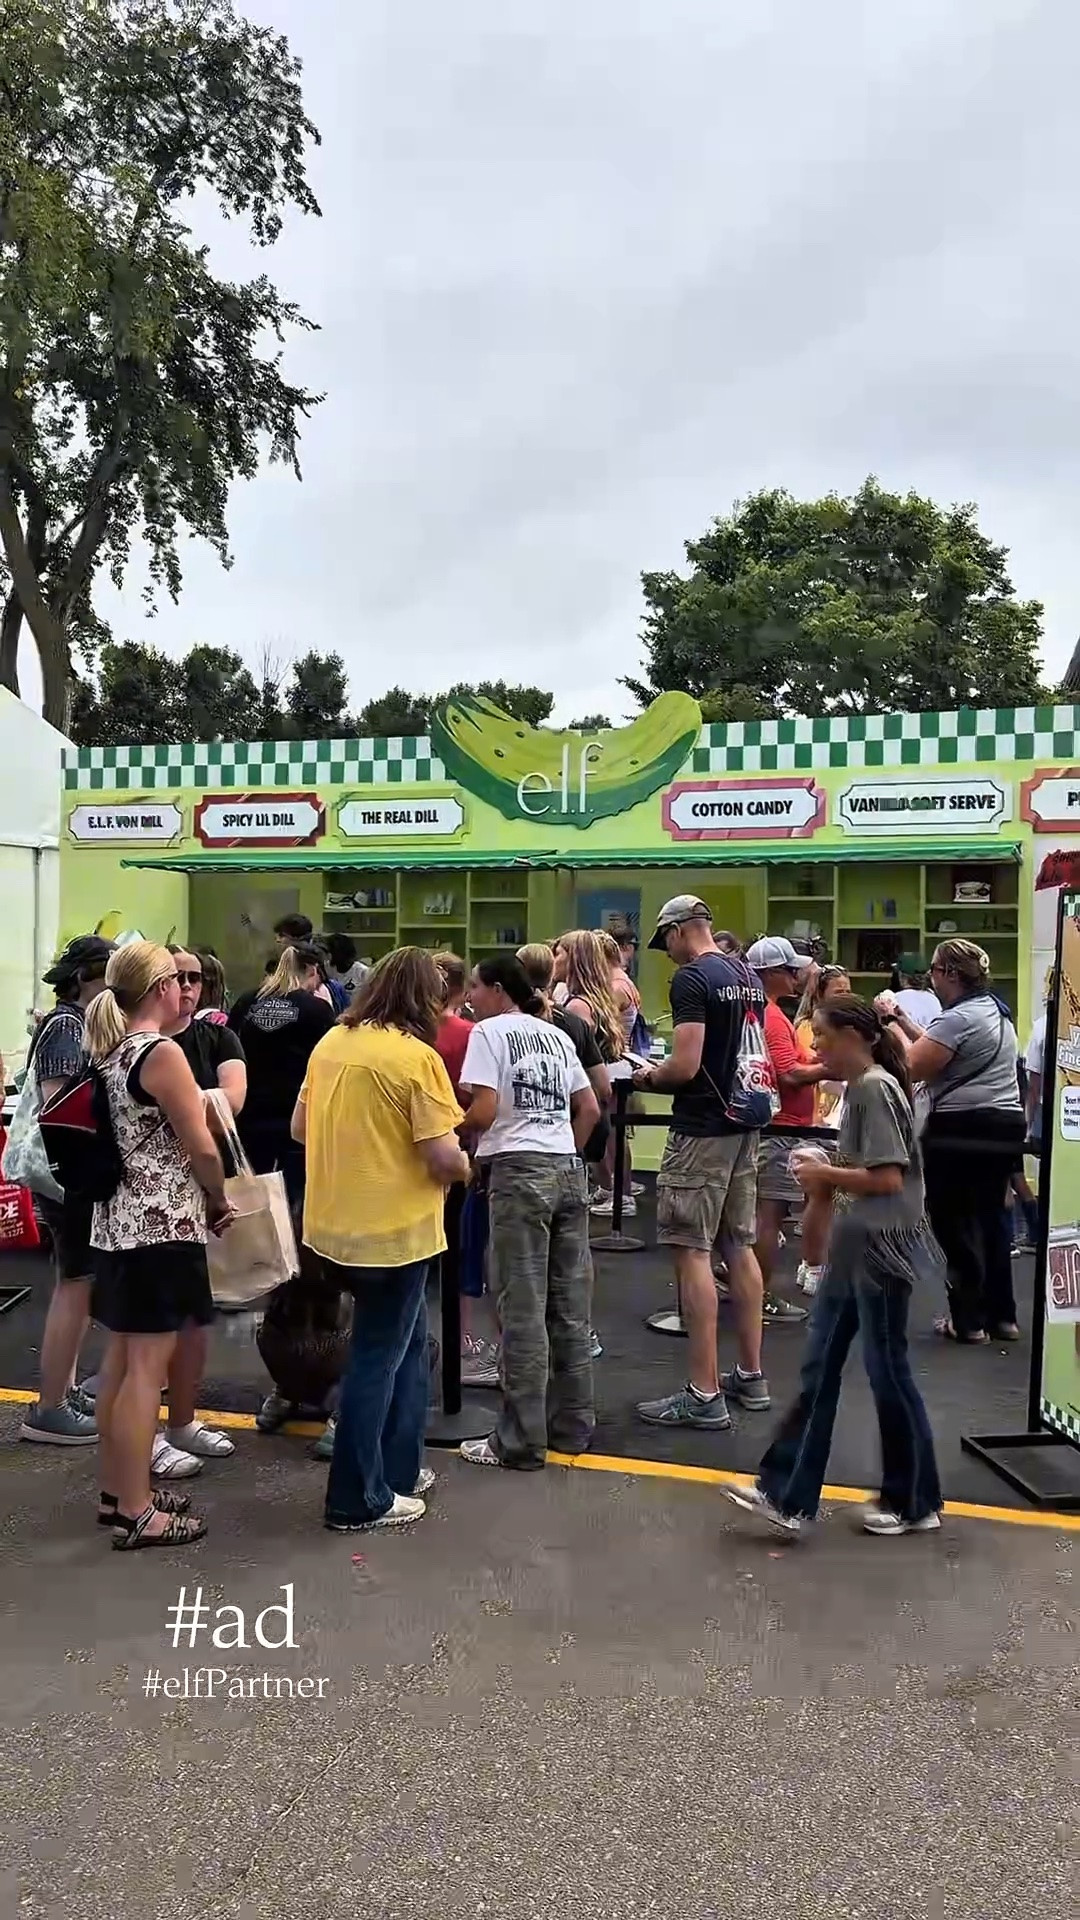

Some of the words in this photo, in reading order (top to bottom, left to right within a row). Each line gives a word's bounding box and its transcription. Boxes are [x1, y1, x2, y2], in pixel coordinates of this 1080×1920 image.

[691, 802, 743, 817] COTTON
[746, 800, 793, 816] CANDY
[849, 798, 909, 812] VANA
[949, 795, 996, 809] SERVE
[222, 814, 253, 827] SPICY
[255, 813, 271, 827] LIL
[272, 813, 295, 826] DILL
[361, 811, 382, 825] THE
[383, 810, 413, 824] REAL
[414, 809, 439, 823] DILL
